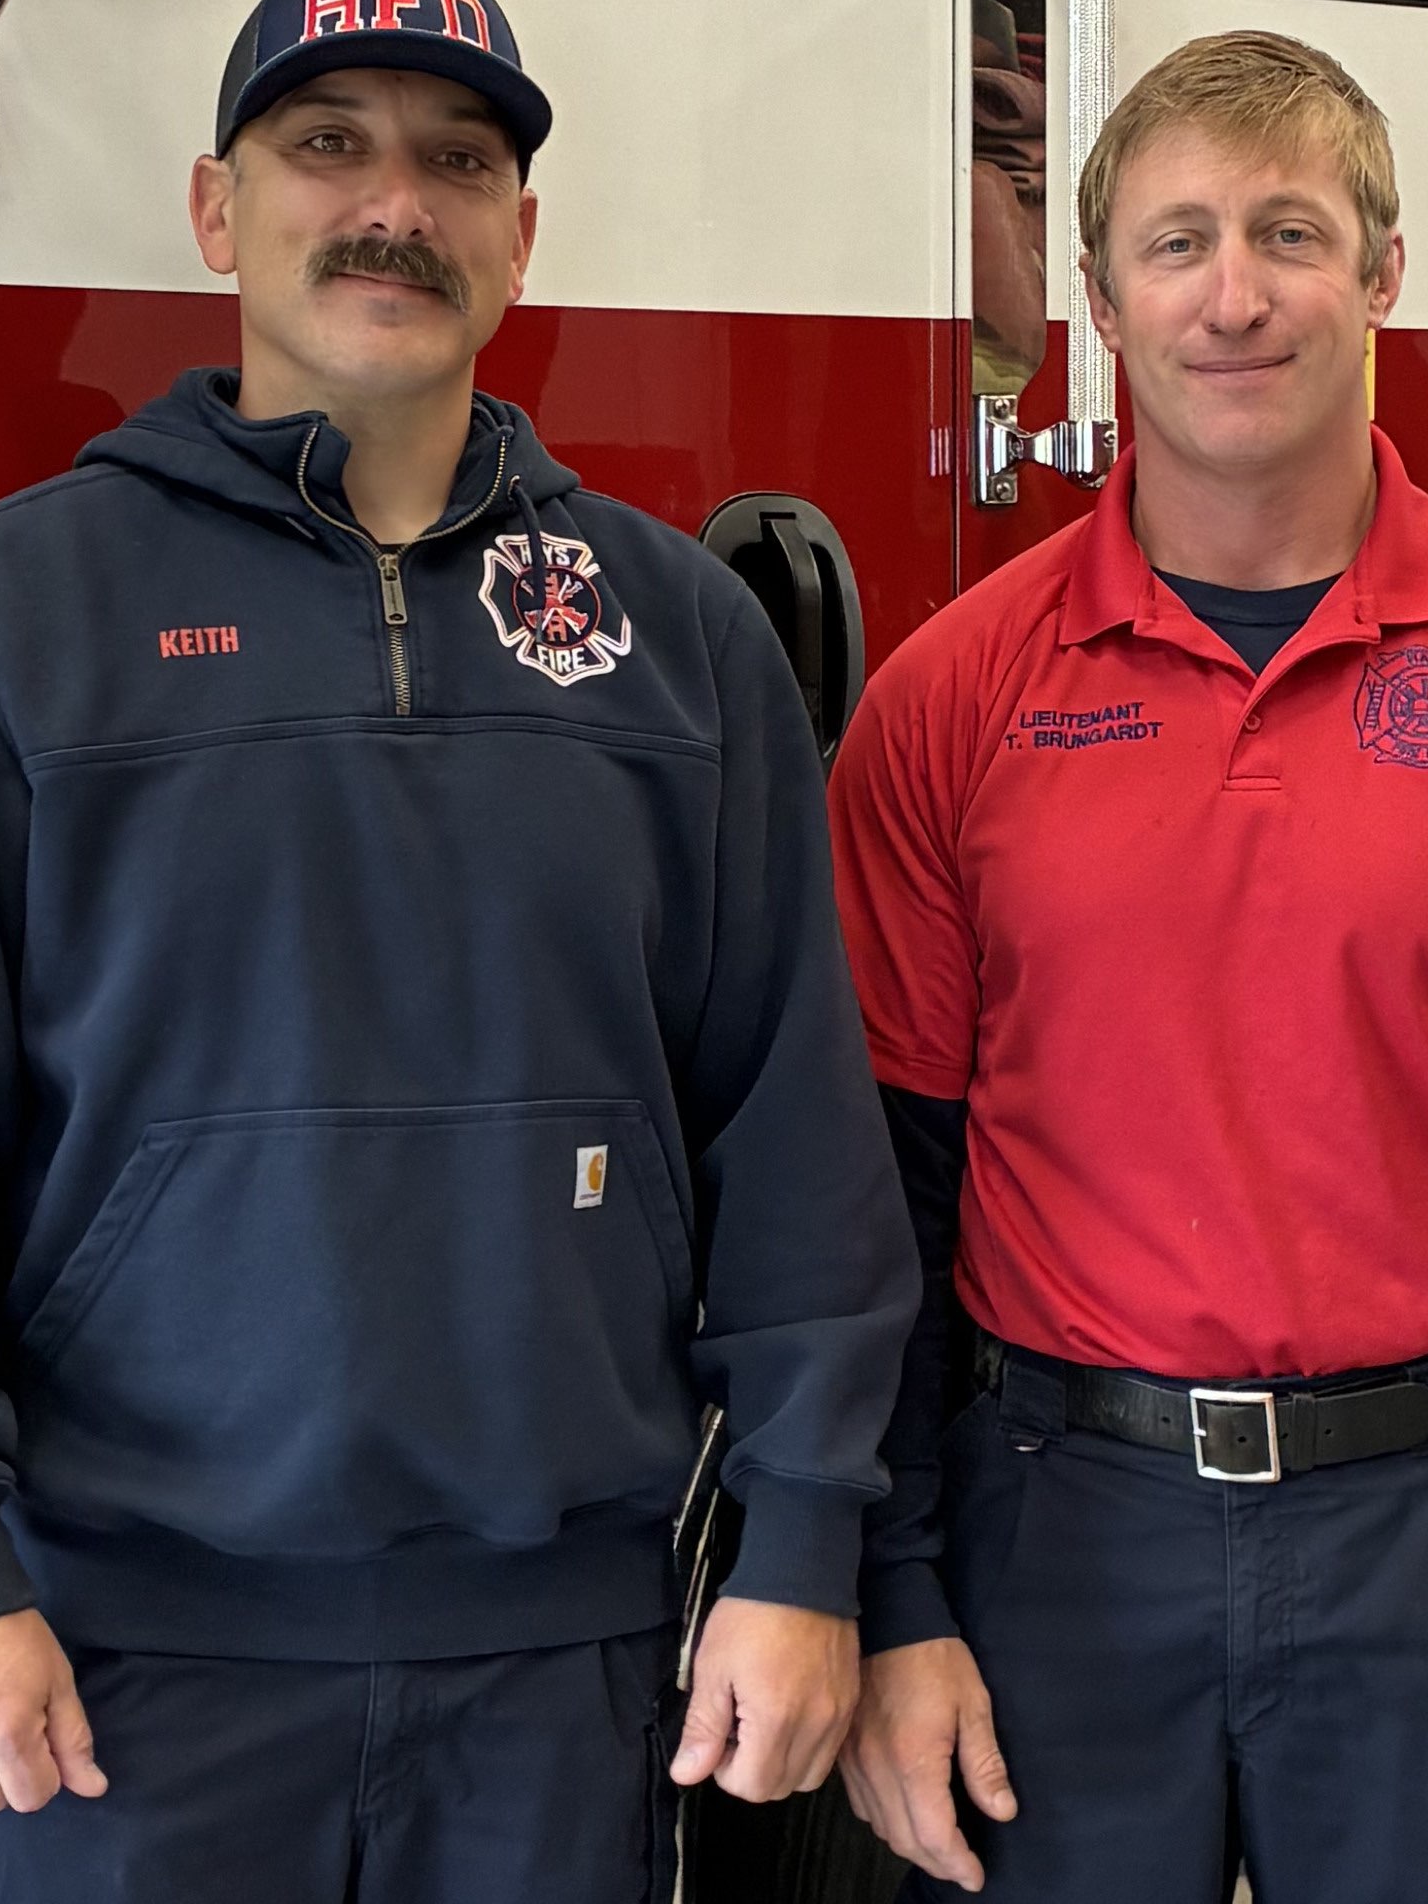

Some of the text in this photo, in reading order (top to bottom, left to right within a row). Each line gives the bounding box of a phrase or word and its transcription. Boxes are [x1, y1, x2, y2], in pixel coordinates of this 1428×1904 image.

[520, 543, 571, 566] HYS
[158, 625, 240, 659] KEITH
[536, 644, 587, 673] FIRE
[1019, 701, 1145, 730] LIEUTENANT
[1005, 721, 1164, 750] T. BRUNGARDT
